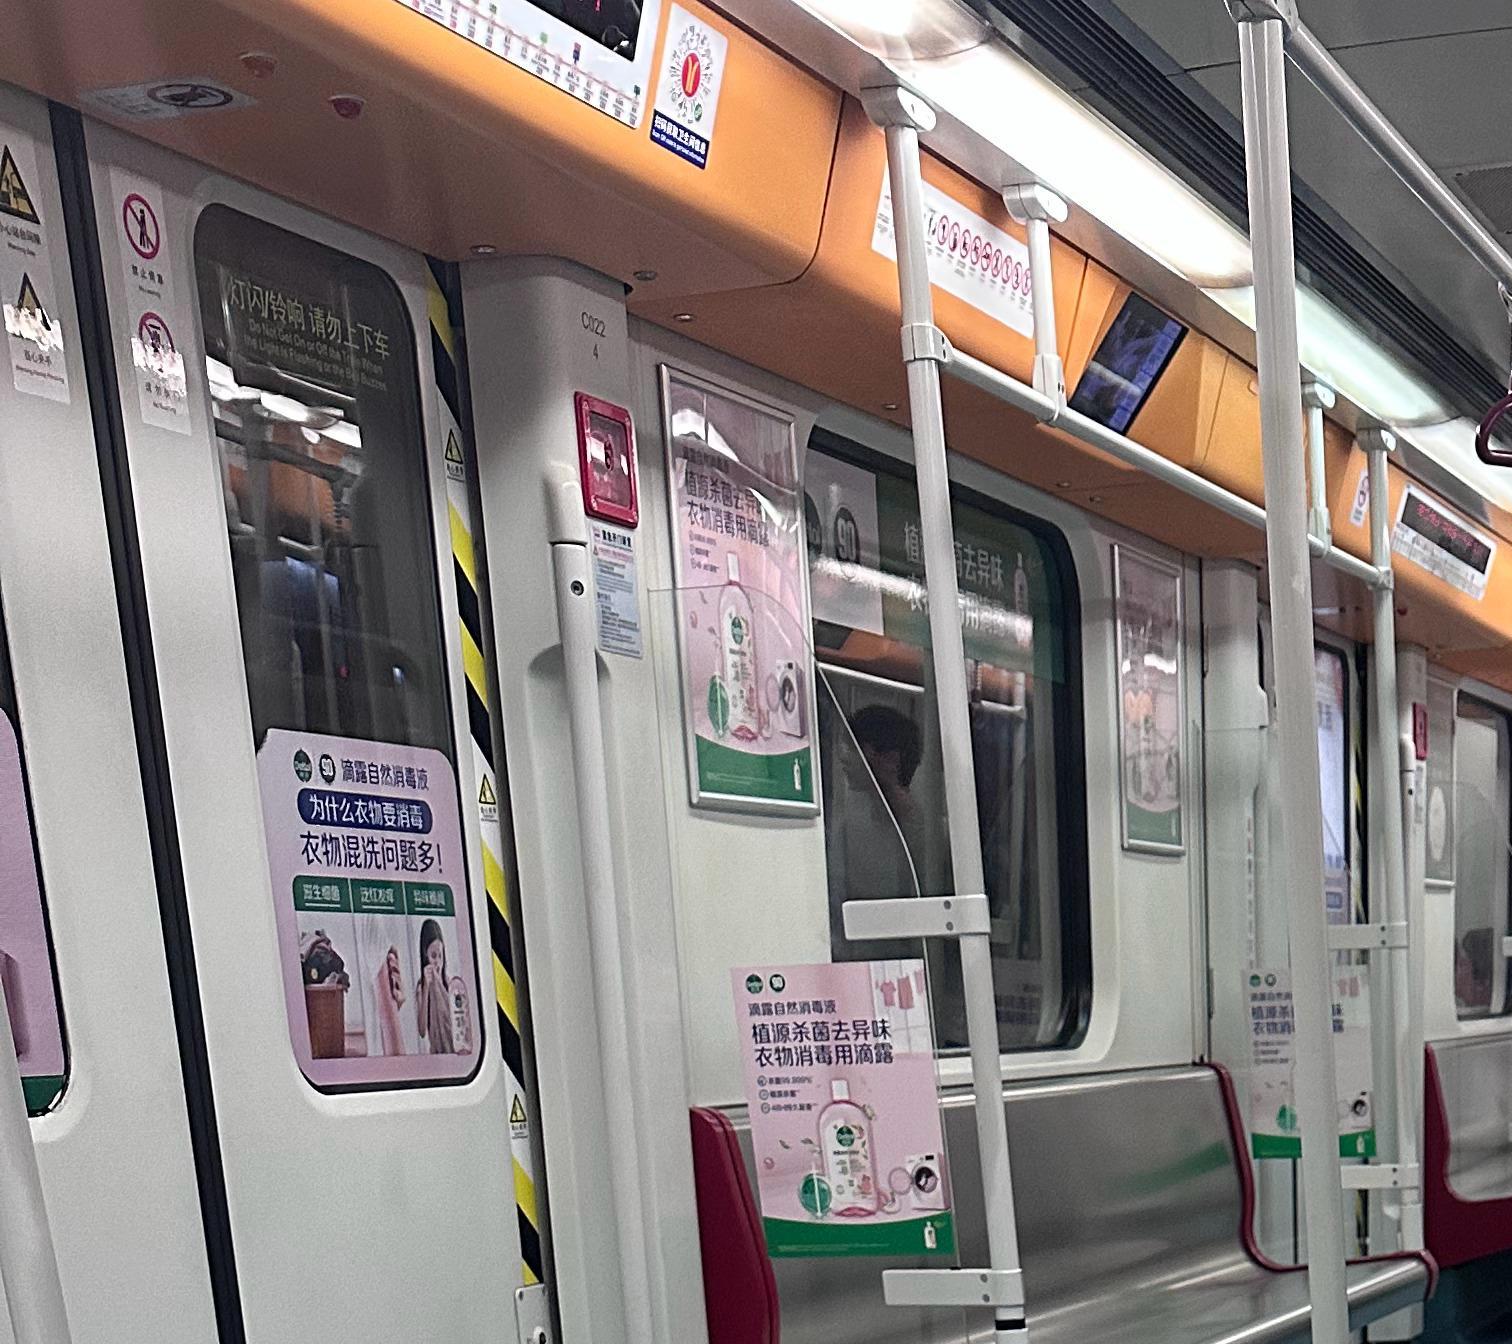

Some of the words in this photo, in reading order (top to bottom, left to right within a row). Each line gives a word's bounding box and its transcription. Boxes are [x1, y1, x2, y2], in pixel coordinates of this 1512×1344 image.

[309, 303, 390, 360] 请勿上下车
[581, 311, 606, 338] C022
[342, 758, 430, 791] 滴露自然消毒液
[309, 794, 424, 830] 为什么衣物要消毒
[752, 1019, 892, 1045] 植源杀菌去异味
[755, 1043, 894, 1067] 衣物消毒用滴露
